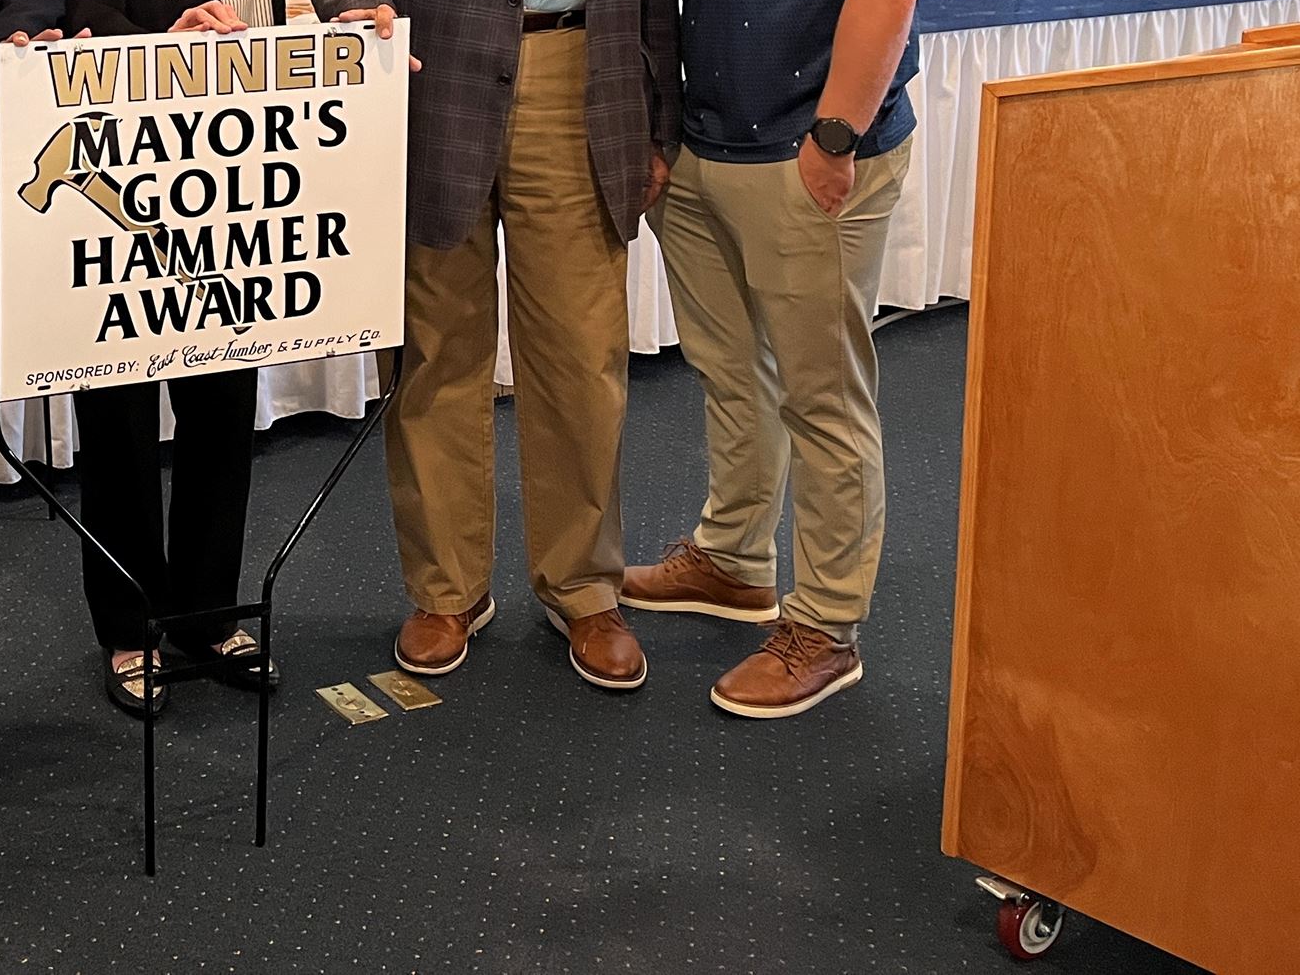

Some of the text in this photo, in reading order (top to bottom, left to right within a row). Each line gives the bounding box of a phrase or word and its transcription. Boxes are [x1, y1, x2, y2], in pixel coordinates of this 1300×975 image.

[47, 32, 366, 108] WINNER
[69, 99, 349, 172] MAYOR'S
[122, 161, 301, 224] GOLD
[70, 211, 351, 289] HAMMER
[94, 270, 322, 343] AWARD
[25, 363, 113, 386] SPONSORED
[116, 360, 140, 375] BY:
[146, 348, 179, 378] East
[182, 345, 222, 368] Coast
[221, 338, 273, 362] Lumber
[277, 341, 288, 353] &
[291, 332, 357, 351] SUPPLY
